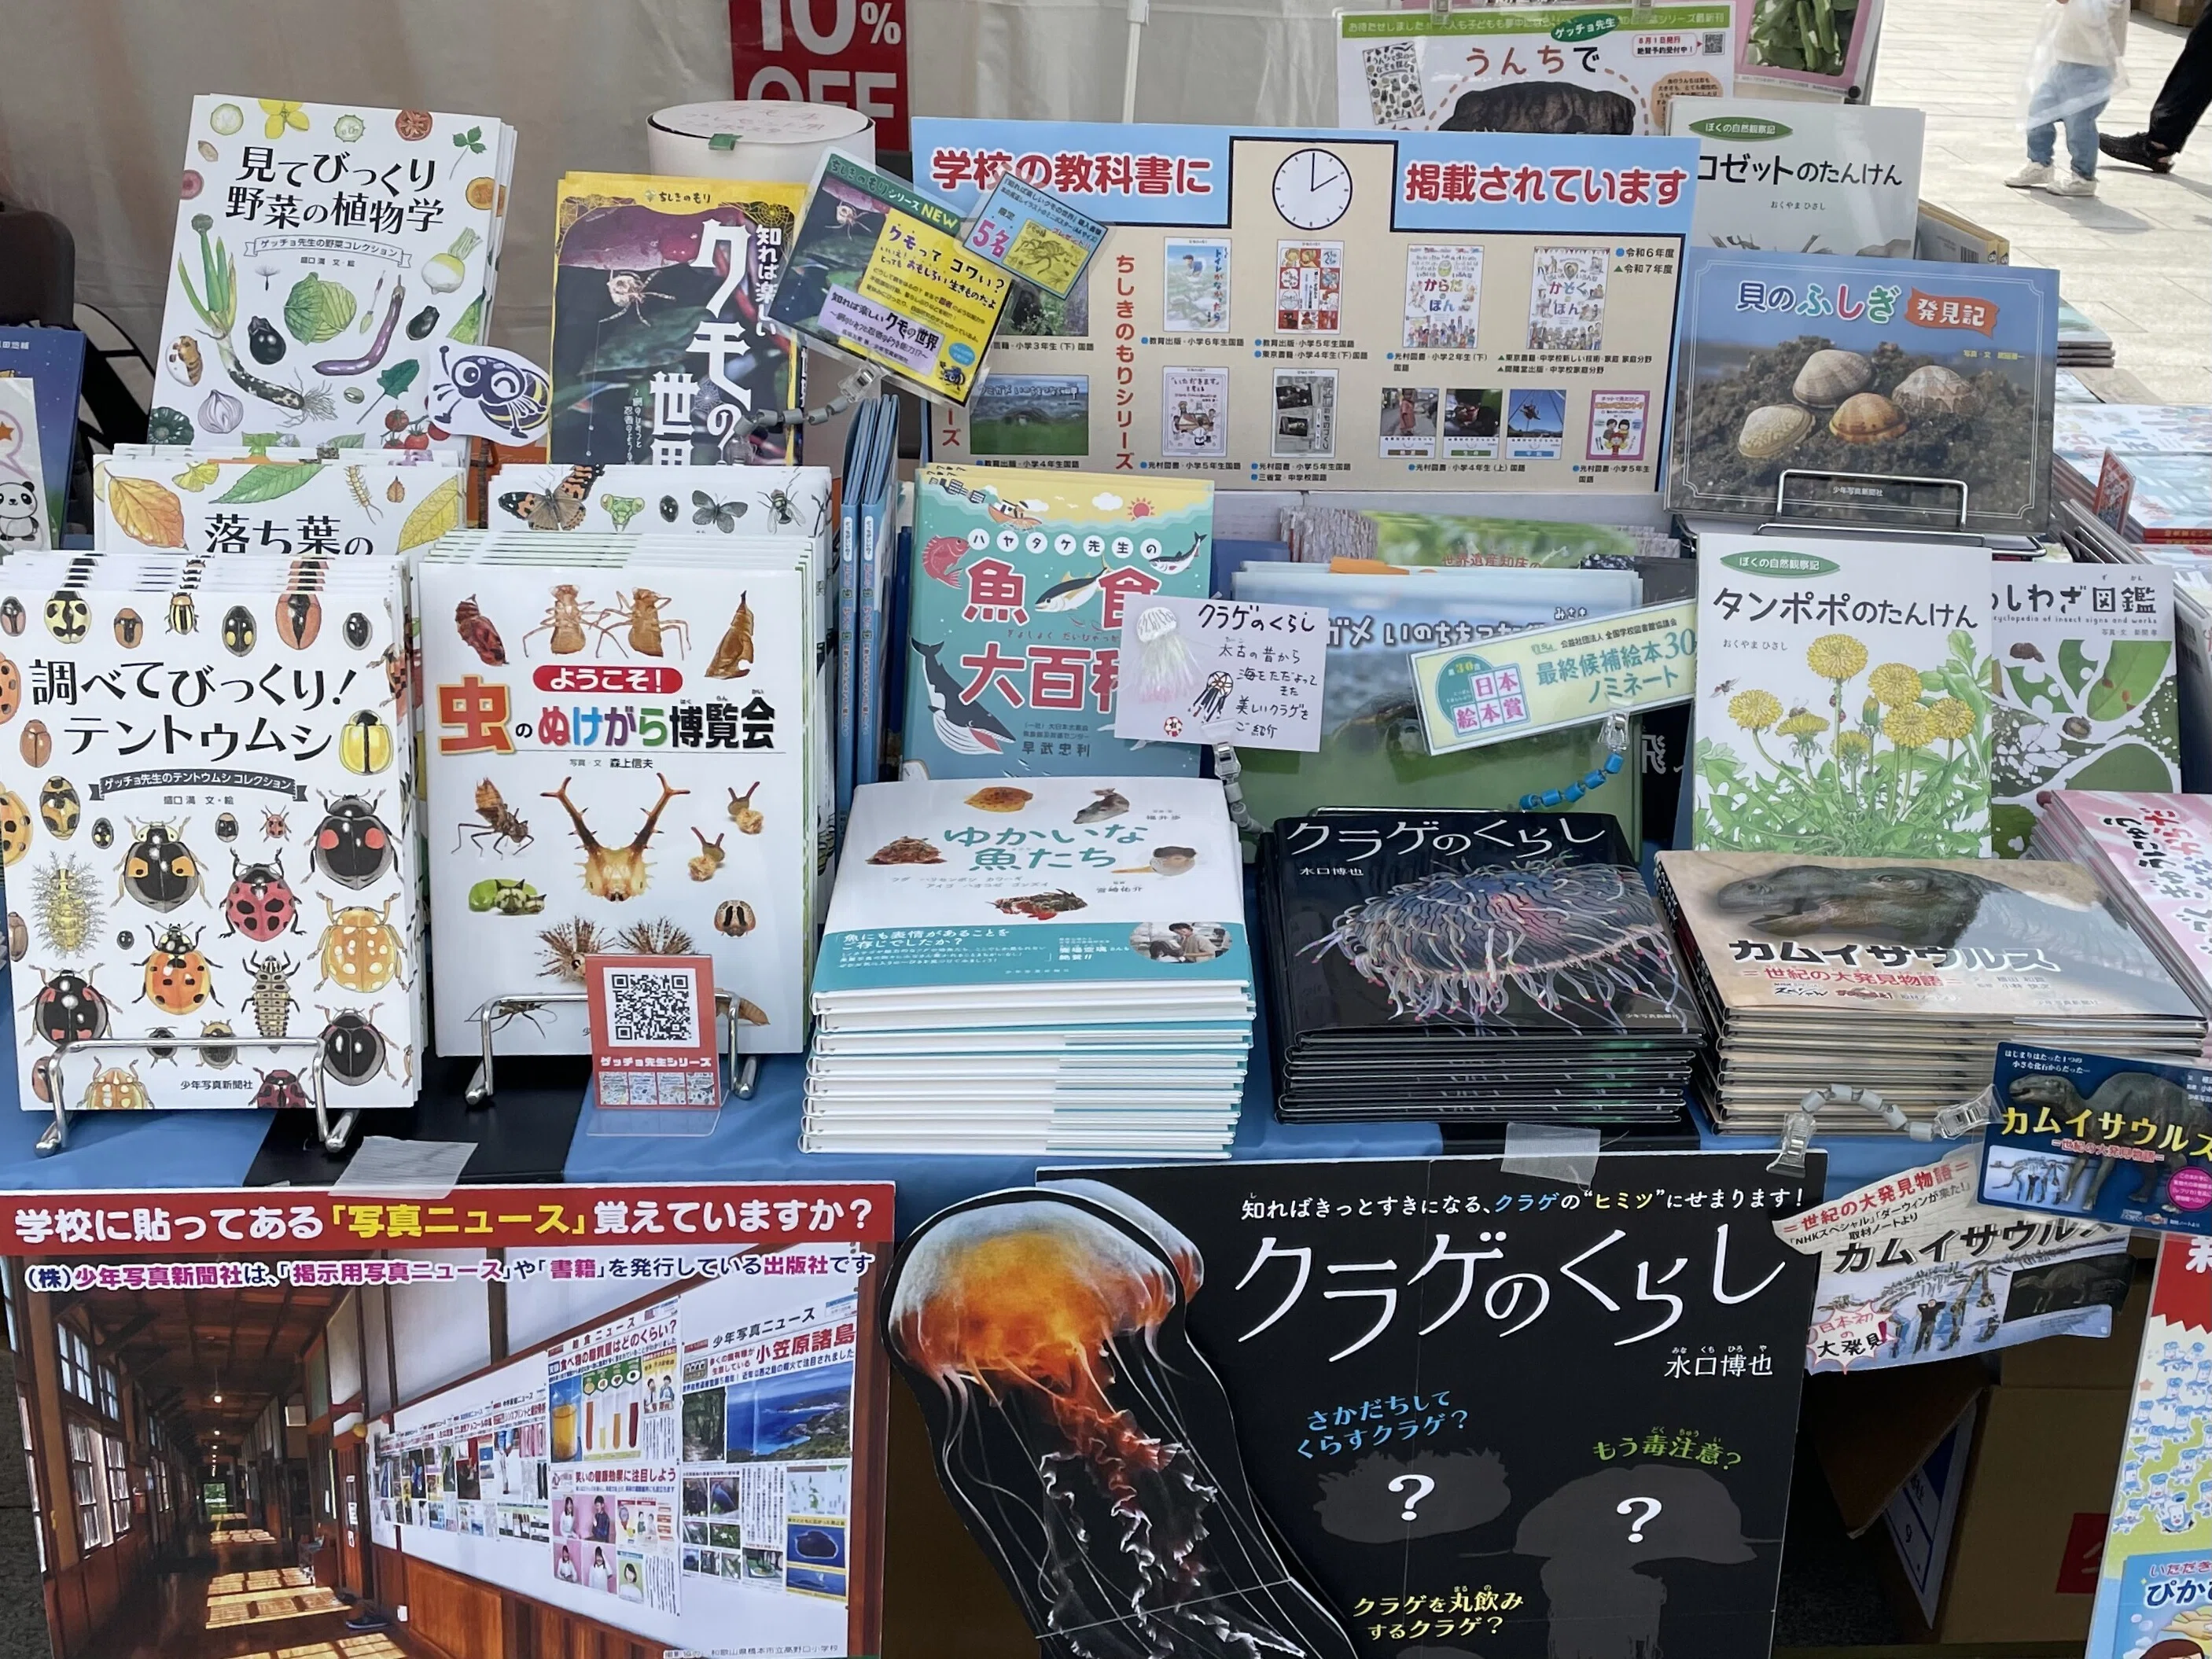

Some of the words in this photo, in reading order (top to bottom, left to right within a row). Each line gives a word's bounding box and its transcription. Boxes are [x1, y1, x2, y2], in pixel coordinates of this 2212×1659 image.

[1555, 17, 1617, 39] ゲッチョ先生
[1467, 44, 1600, 76] うんちで
[748, 66, 897, 118] OFF
[1705, 121, 1776, 135] ぼくの自然観察記
[236, 145, 436, 197] 見てびっくり
[933, 149, 1212, 194] 学校の教科書に
[659, 191, 711, 204] ちしきのもり
[1405, 164, 1688, 206] 掲載されています
[225, 186, 445, 235] 野菜の植物学
[921, 203, 959, 230] NEW
[260, 237, 398, 258] ゲッチョ先生の野菜コレクション
[973, 219, 1012, 259] 5名
[1626, 248, 1675, 259] 令和6年度
[756, 225, 782, 337] 知れば楽しい
[950, 257, 1007, 295] コワい?
[1624, 263, 1674, 275] 令和7年度
[1735, 280, 1901, 324] 貝のふしぎ
[1916, 297, 1987, 328] 発見記
[686, 218, 752, 448] クモの
[991, 341, 1094, 351] 書籍・小学3年生(下)国語
[1150, 337, 1245, 347] 教育出版・小学6年生国語
[1263, 340, 1355, 348] 教育出版・小学5年生国語
[1115, 254, 1135, 470] ちしきのもりシリーズ
[1148, 462, 1242, 470] 光村図書・小学5年生国語
[1258, 462, 1352, 471] 光村図書・小学5年生国語
[1258, 473, 1328, 482] 三省堂・中学校国語
[204, 513, 374, 555] 落ち葉の
[971, 532, 1158, 555] ハヤタケ先生の
[1739, 556, 1820, 572] ぼくの自然観察記
[1198, 603, 1316, 634] クラゲのくらし
[1554, 606, 1587, 620] みさき
[1713, 585, 1978, 630] タンポポのたんけん
[1992, 615, 2039, 624] cyclopedia
[2056, 615, 2081, 624] insect
[2085, 616, 2109, 625] signs
[1218, 642, 1301, 664] 太古の昔から
[1536, 628, 1696, 687] 最終候補絵本30
[1722, 638, 1760, 649] おくやま
[1761, 638, 1789, 652] ひさし
[28, 659, 358, 712] 調べてびっくり!
[550, 669, 663, 693] ようこそ!
[1236, 667, 1318, 686] 海をただよって
[1474, 672, 1518, 698] 日本
[1588, 667, 1679, 704] ノミネート
[1279, 686, 1300, 697] きた
[436, 674, 776, 756] 虫のぬけがら博覧会
[1235, 695, 1309, 721] 美しいクラゲを
[1456, 696, 1524, 730] 絵本賞
[1235, 721, 1279, 740] ご紹介
[1023, 741, 1091, 758] 早武忠利
[610, 757, 653, 769] 森上信夫
[943, 824, 1150, 845] ゆかいな
[1286, 818, 1607, 863] クラゲのくらし
[968, 847, 1117, 871] 魚たち
[1299, 866, 1364, 877] 水口博也
[1728, 940, 2062, 973] カムイサウルス
[600, 1056, 712, 1069] ゲッチョ先生シリーズ
[180, 1080, 254, 1091] 少年写真新聞社
[2000, 1105, 2212, 1162] カムイサウルス
[1849, 1212, 1919, 1241] 取材ノートより
[1235, 1223, 1786, 1363] クラゲのくらし
[712, 1307, 816, 1348] 少年写真ニュース
[1819, 1311, 1875, 1334] 日本初
[1840, 1328, 1854, 1340] の
[756, 1322, 857, 1365] 小笠原諸島
[1663, 1353, 1773, 1380] 水口博也
[1306, 1390, 1452, 1432] さかだちして
[1297, 1408, 1469, 1459] くらすクラゲ?
[1592, 1433, 1743, 1471] もう毒注意?
[1353, 1590, 1525, 1617] クラゲを丸飲み
[2146, 1579, 2212, 1607] ぴか
[1367, 1616, 1504, 1642] するクラゲ?
